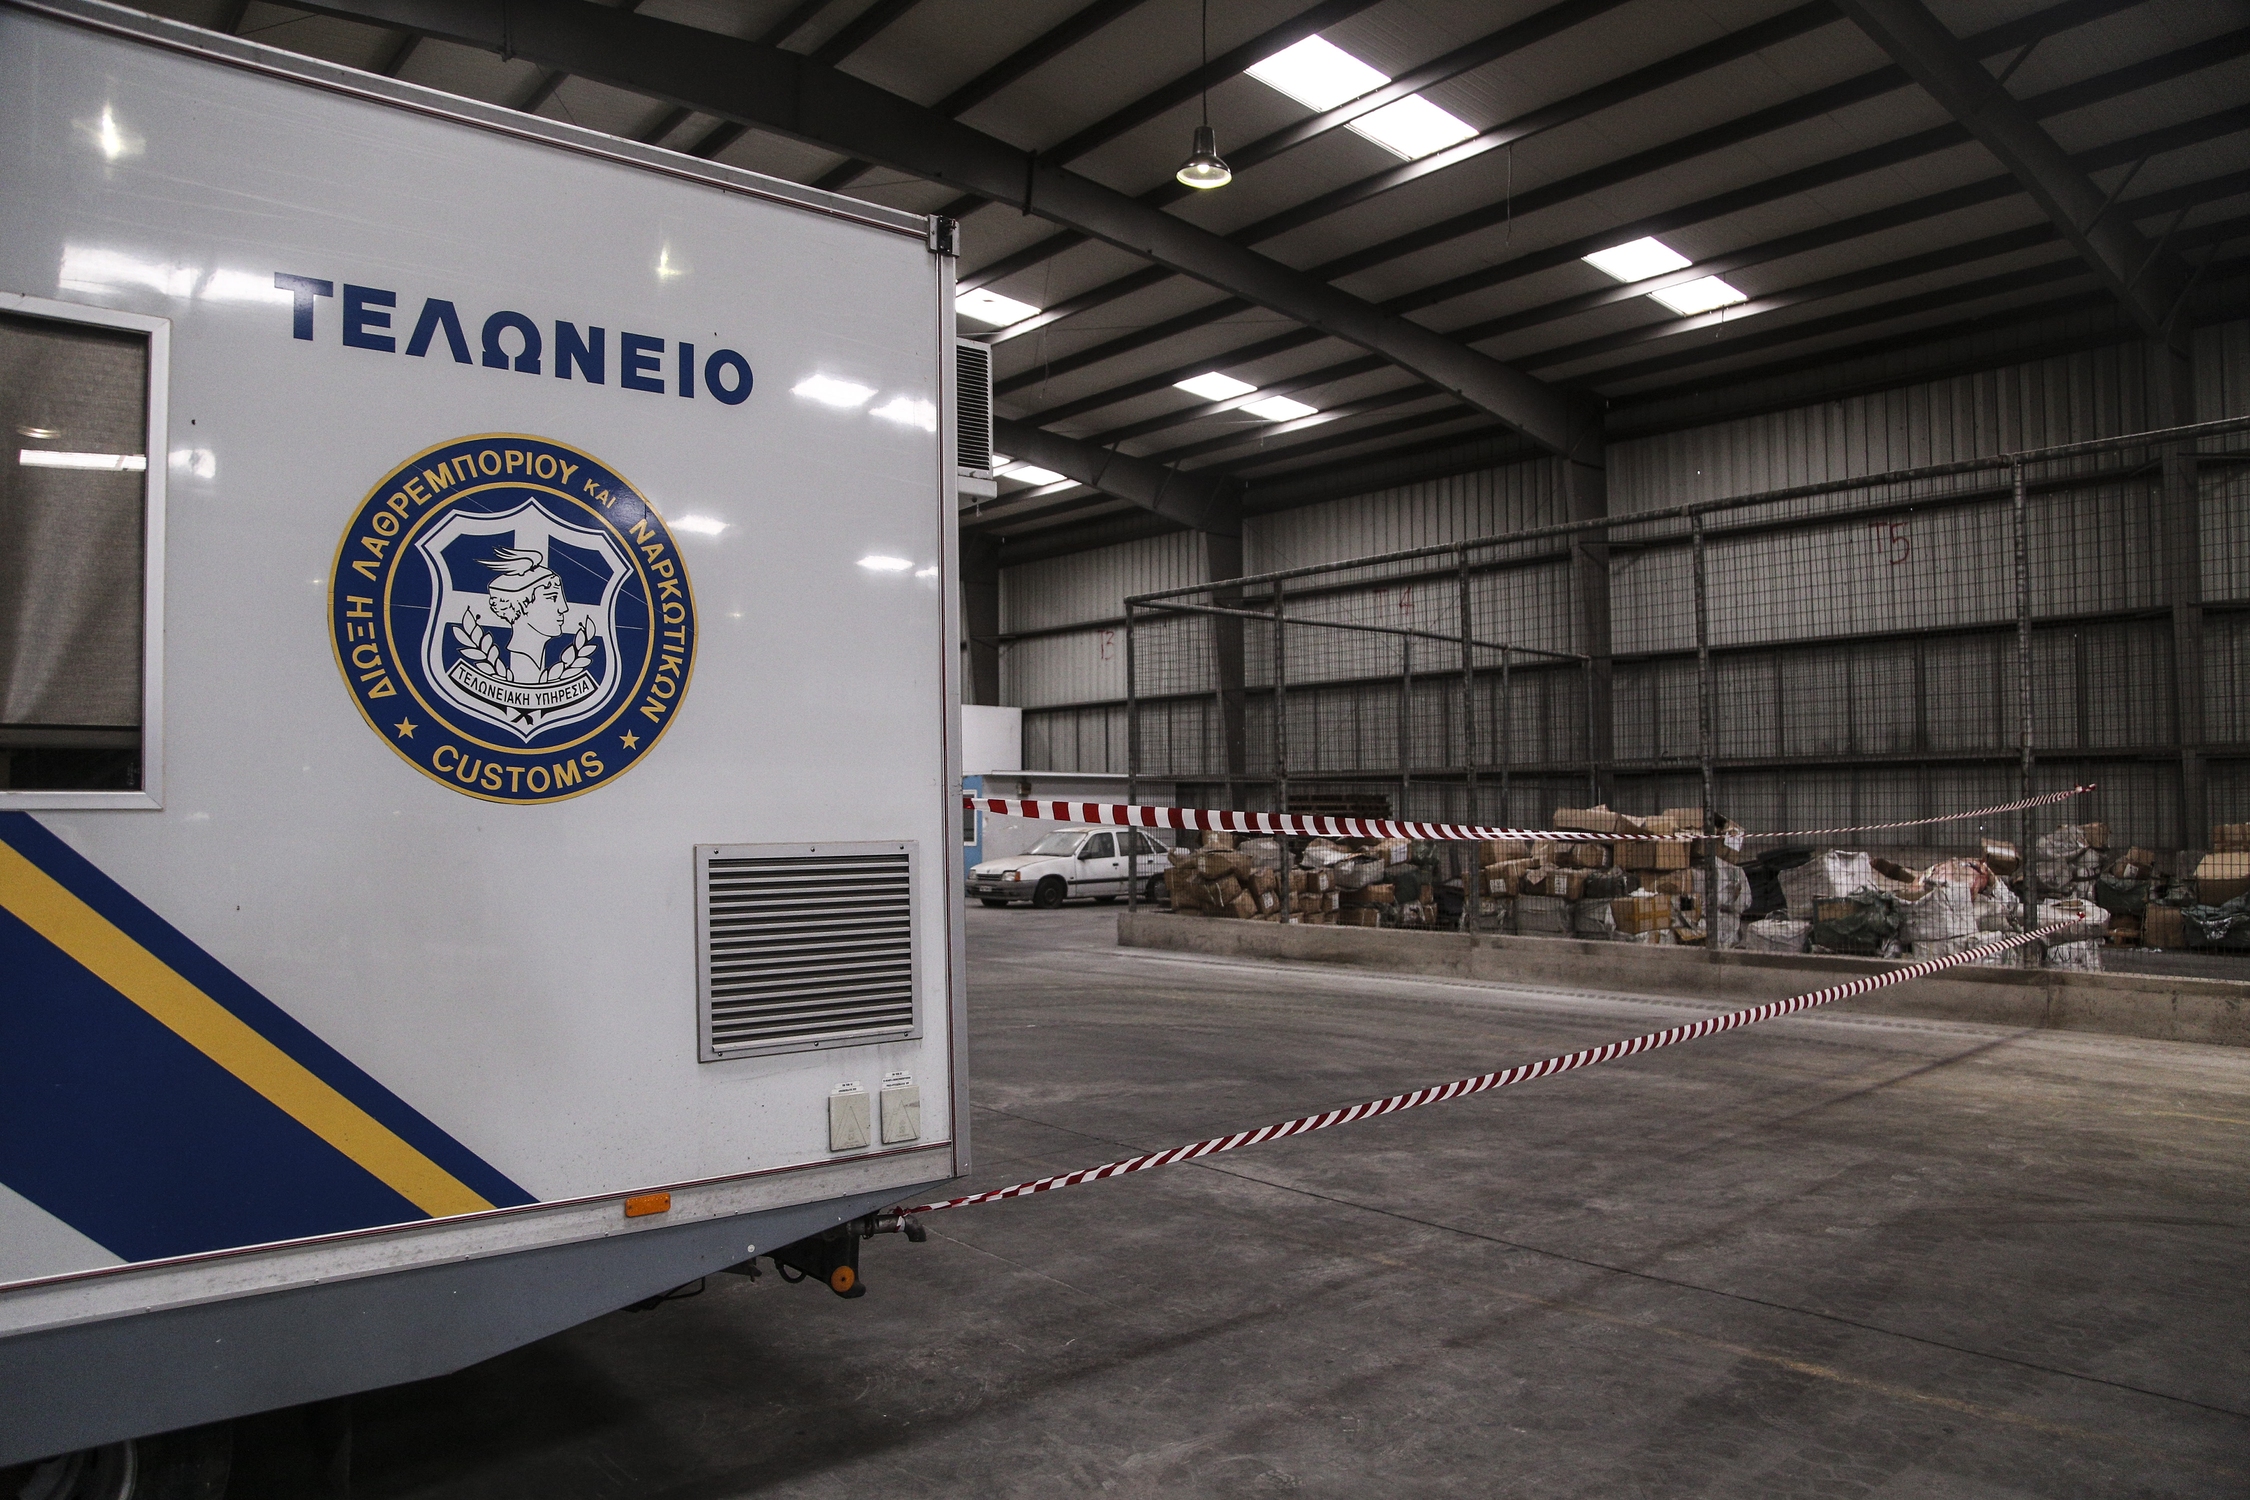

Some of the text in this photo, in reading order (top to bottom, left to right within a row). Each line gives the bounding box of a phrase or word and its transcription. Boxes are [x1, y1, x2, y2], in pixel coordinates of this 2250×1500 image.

[274, 271, 754, 406] ΤΕΛΩΝΕΙΟ
[346, 449, 686, 724] ΔΙΩΞΗ ΛΑΘΡΕΜΠΟΡΙΟΥ ΚΑΙ ΝΑΡΚΩΤΙΚΩΝ
[459, 666, 590, 706] ΤΕΛΩΝΕΙΑΚΗ ΥΠΗΡΕΣΙΑ
[432, 744, 605, 793] CUSTOMS
